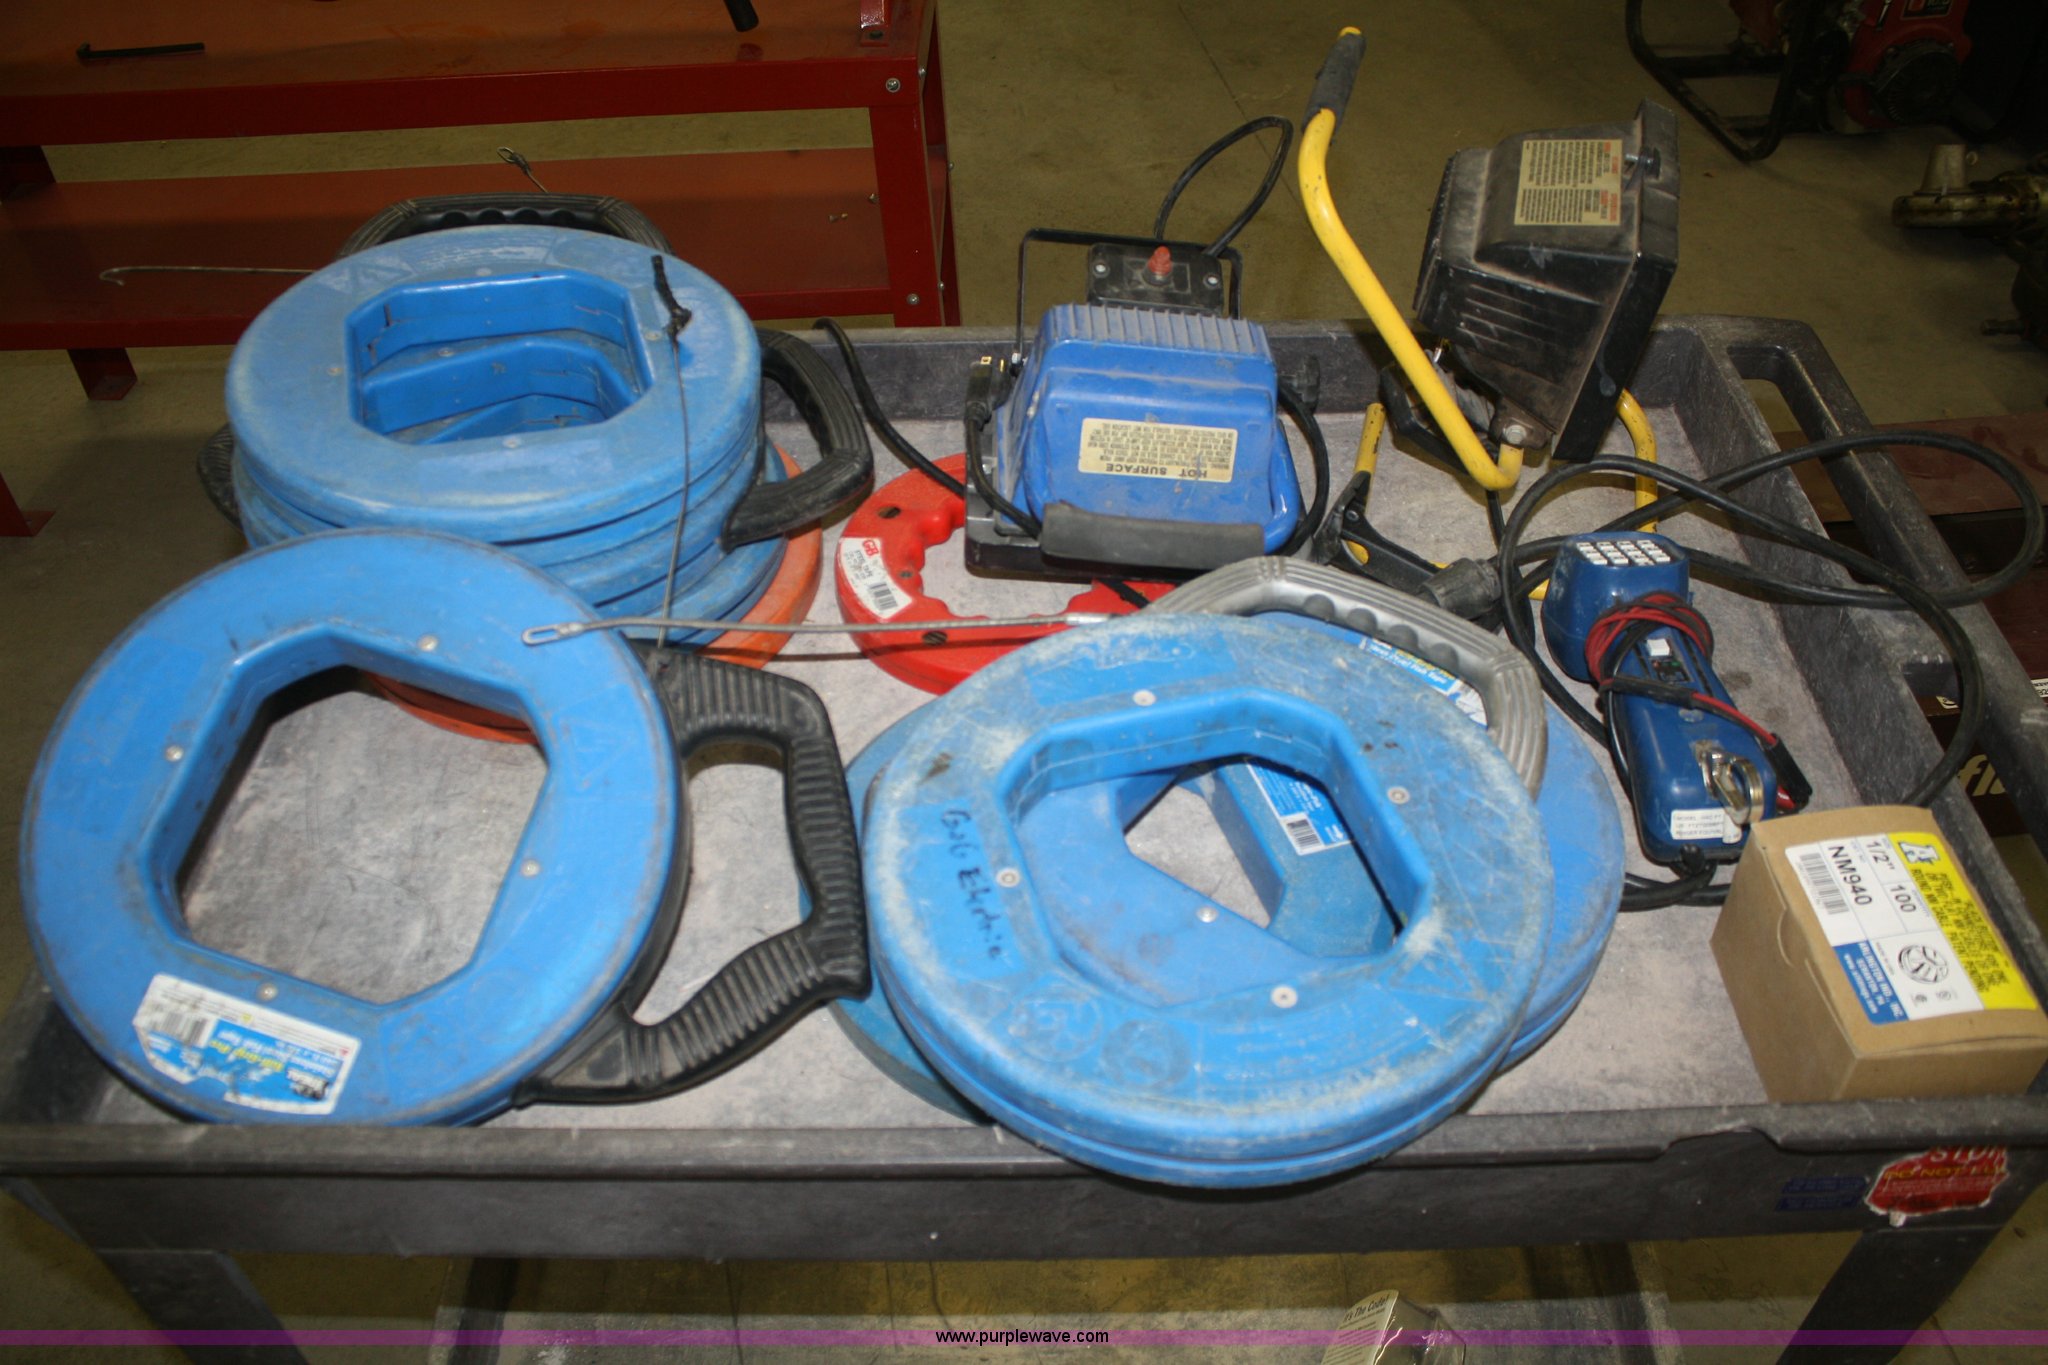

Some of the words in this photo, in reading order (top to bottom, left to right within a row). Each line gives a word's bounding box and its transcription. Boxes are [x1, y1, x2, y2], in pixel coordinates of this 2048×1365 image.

[1106, 463, 1168, 476] SURFACE
[1179, 468, 1207, 479] HOT
[1866, 841, 1895, 870] 1/2"
[1828, 845, 1872, 906] NM940
[1889, 885, 1916, 912] 100
[1920, 1166, 1962, 1178] NOT
[1354, 1306, 1367, 1318] The
